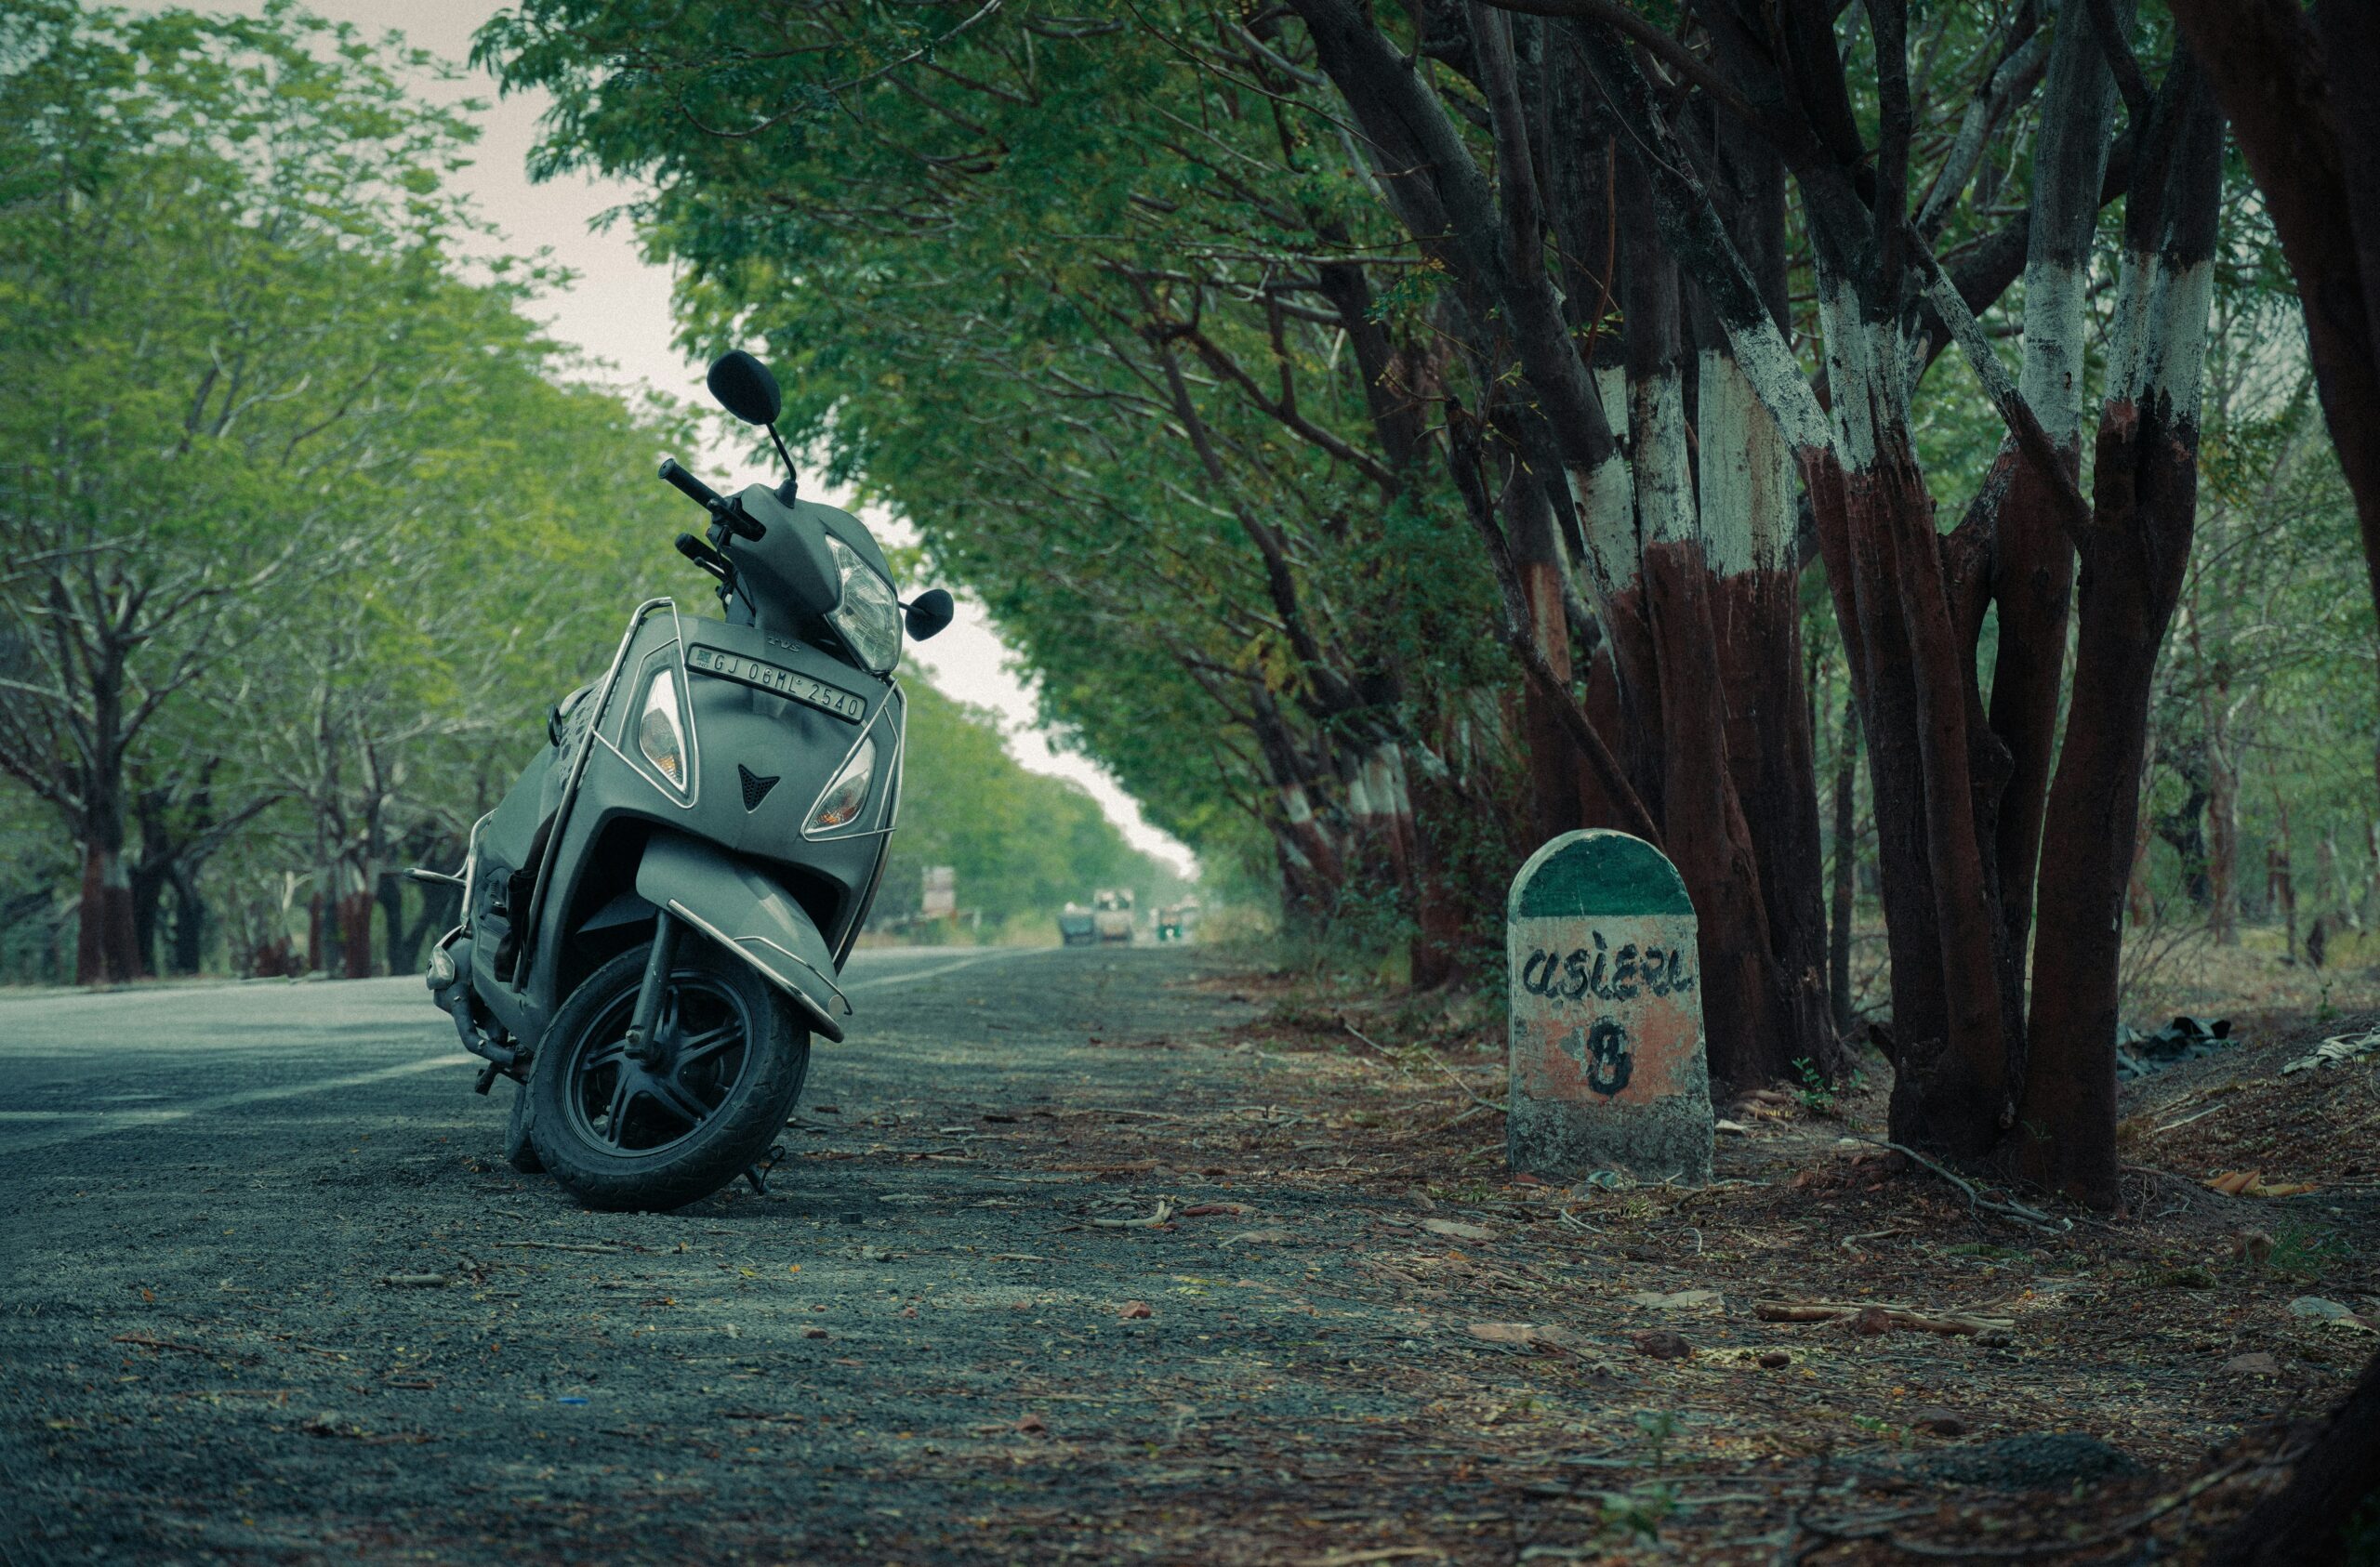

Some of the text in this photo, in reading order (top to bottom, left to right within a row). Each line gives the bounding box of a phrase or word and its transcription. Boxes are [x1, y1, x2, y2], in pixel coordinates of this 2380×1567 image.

[767, 636, 801, 653] TVS
[714, 654, 739, 674] GJ
[809, 684, 858, 716] 2540
